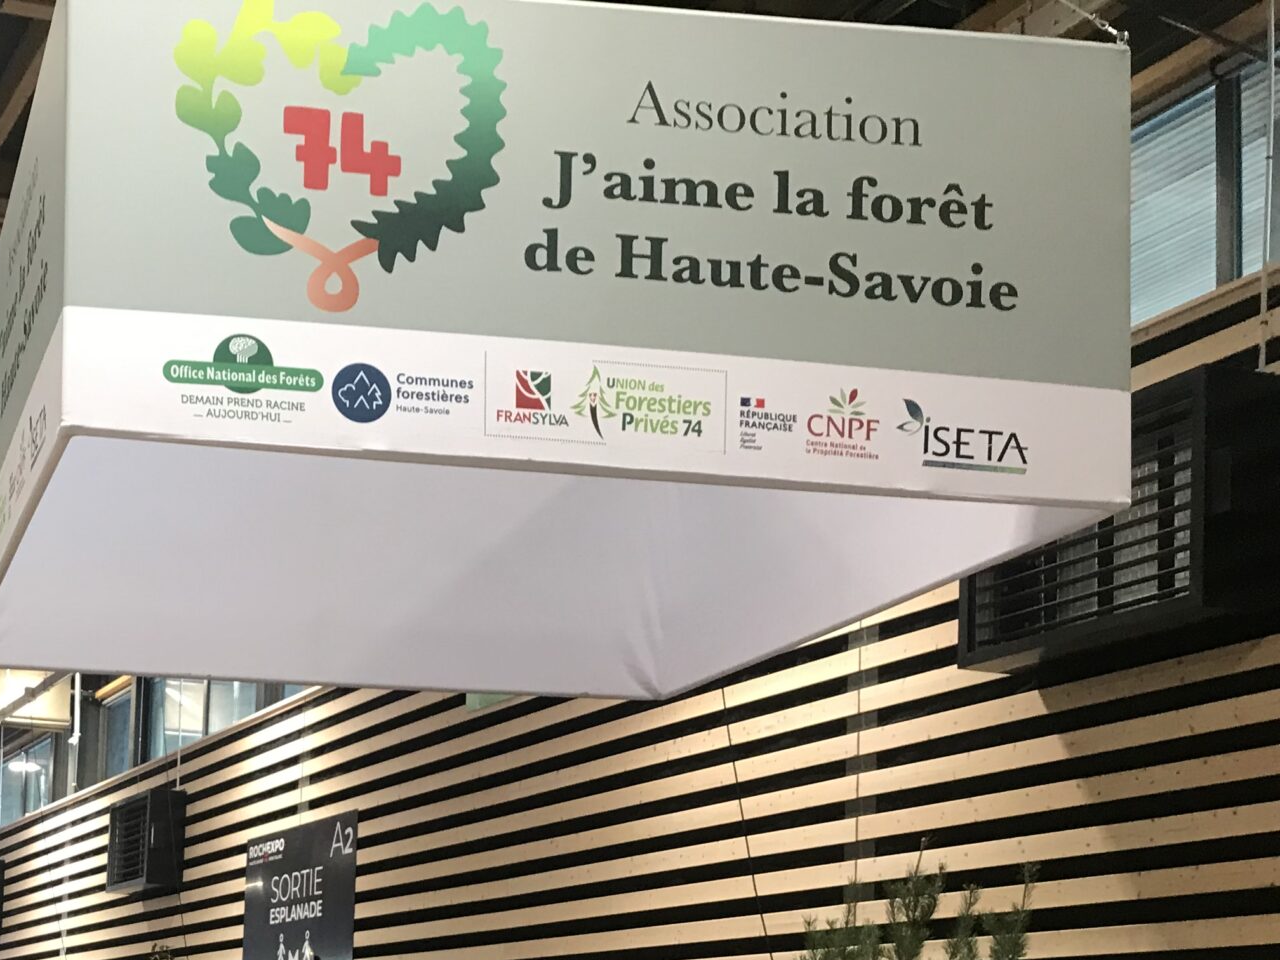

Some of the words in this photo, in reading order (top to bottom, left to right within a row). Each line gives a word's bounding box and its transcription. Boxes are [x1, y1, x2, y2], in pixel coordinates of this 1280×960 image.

[627, 79, 923, 147] Association
[283, 105, 401, 197] 74
[542, 149, 755, 211] J'aime
[772, 169, 830, 218] la
[846, 174, 994, 231] forêt
[523, 227, 596, 275] de
[615, 233, 1019, 312] Haute-Savoie
[171, 365, 205, 380] Office
[206, 367, 256, 383] National
[258, 370, 278, 385] des
[279, 372, 316, 387] Forêts
[396, 373, 474, 389] Communes
[607, 377, 646, 391] UNION
[648, 382, 665, 393] des
[181, 394, 224, 406] DEMAIN
[227, 397, 263, 409] PREND
[266, 400, 306, 412] RACINE
[396, 387, 470, 404] forestières
[615, 391, 712, 417] Forestiers
[206, 408, 281, 423] AUJOURD'HUI
[396, 405, 450, 416] Haute-Savoie
[496, 409, 569, 427] FRANSYLVA
[740, 410, 797, 423] RÉPUBLIQUE
[622, 412, 679, 435] Privés
[682, 419, 703, 437] 74
[739, 420, 793, 432] FRANÇAISE
[807, 414, 880, 441] CNPF
[830, 441, 858, 450] National
[249, 838, 285, 859] ROCHEXPO
[330, 821, 353, 858] A2
[271, 866, 323, 904] SORTIE
[270, 900, 323, 925] ESPLANADE
